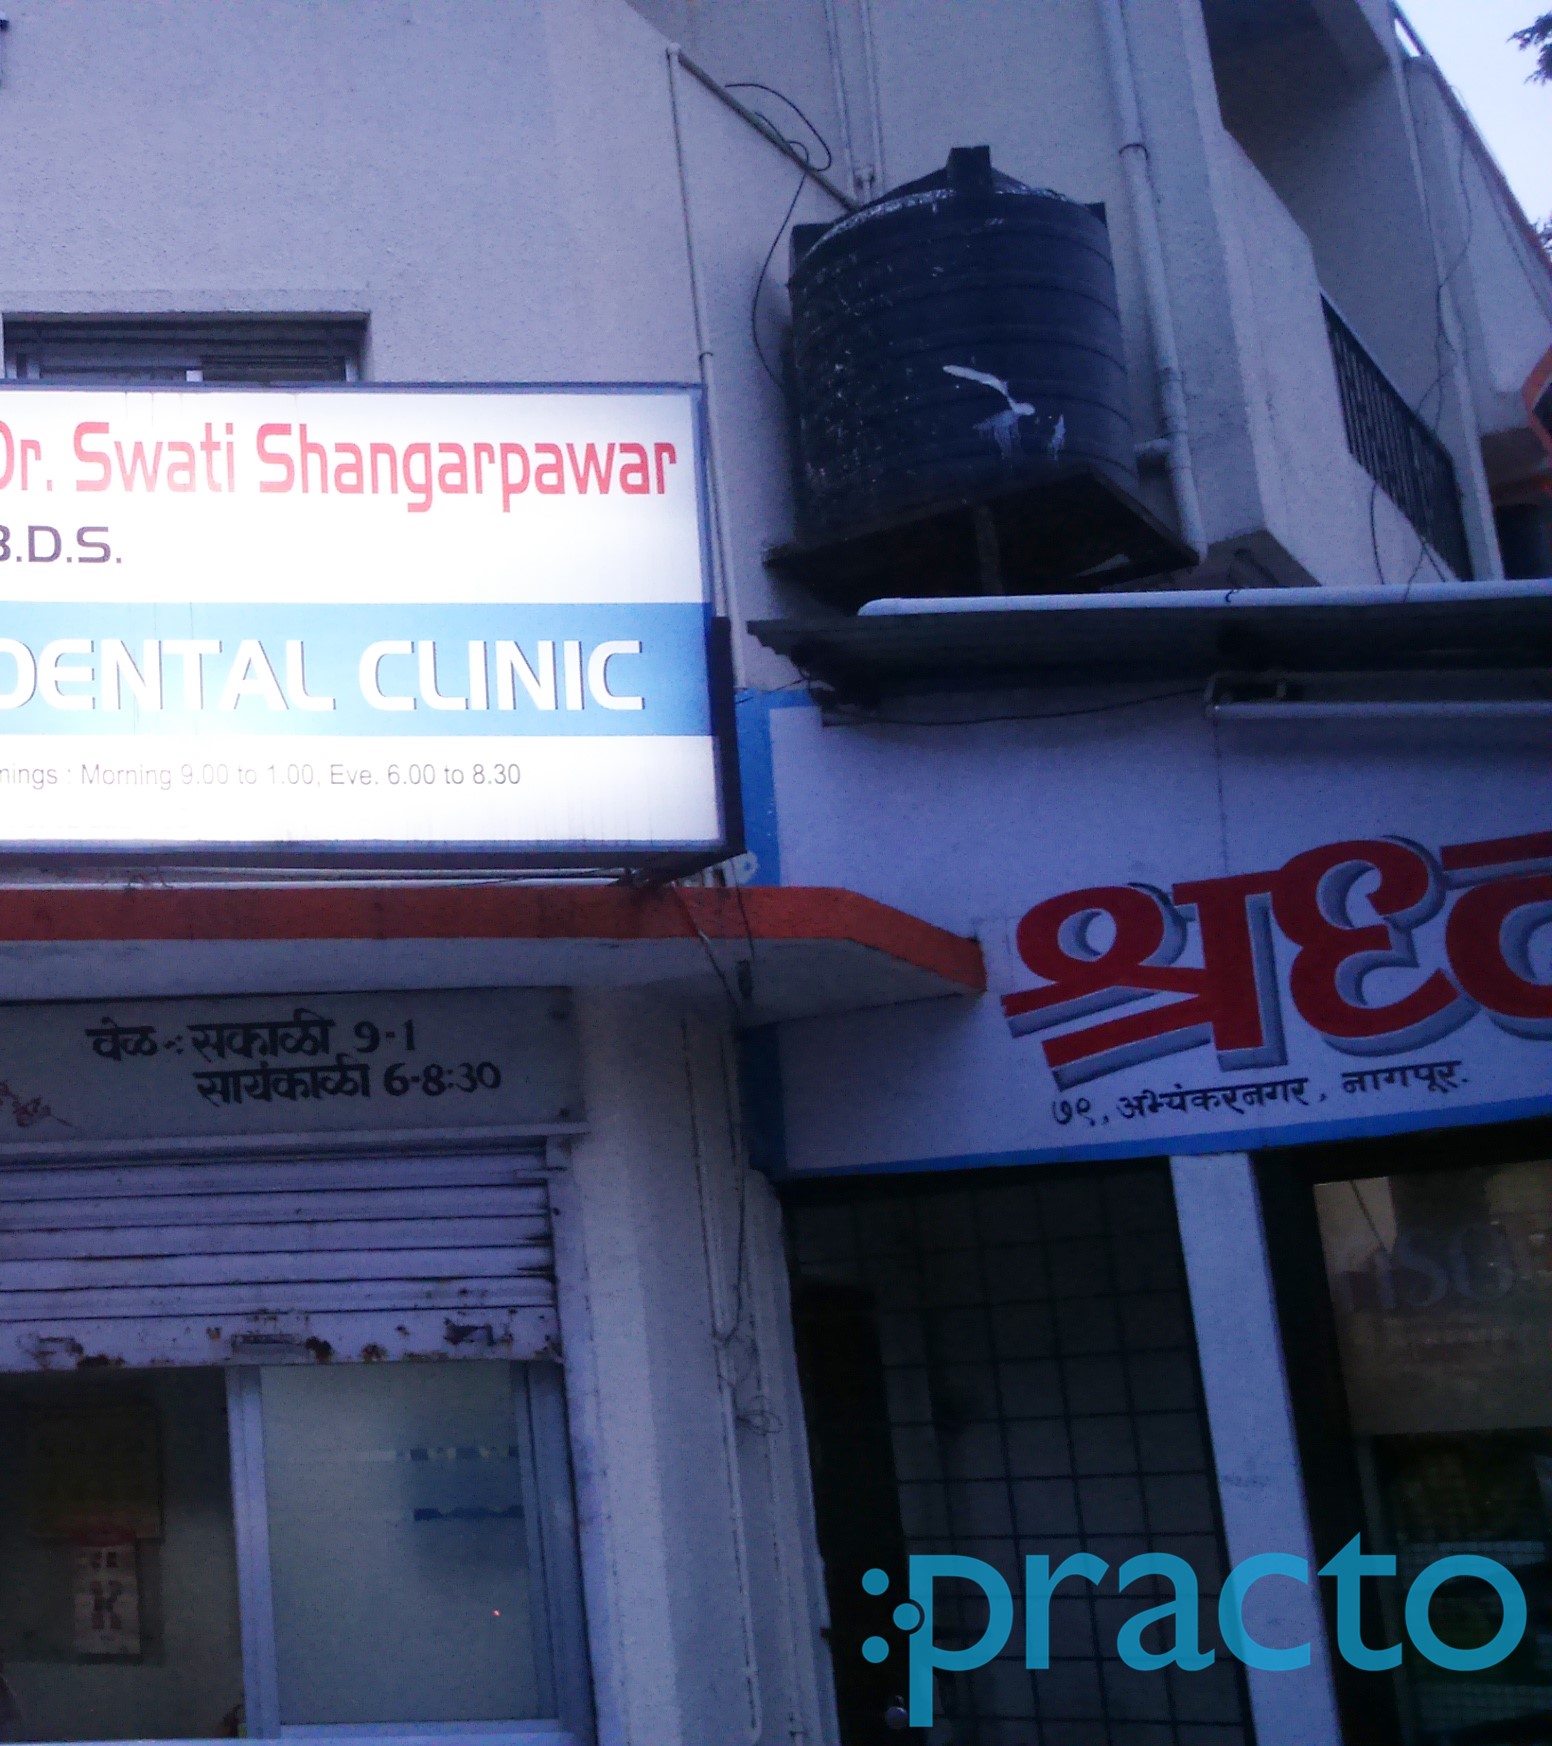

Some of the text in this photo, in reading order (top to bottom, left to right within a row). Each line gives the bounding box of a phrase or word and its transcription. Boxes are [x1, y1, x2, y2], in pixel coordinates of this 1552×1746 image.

[73, 421, 237, 494] Swati
[256, 423, 677, 513] Shangarpawar
[359, 639, 646, 713] CLINIC
[82, 763, 171, 790] Morning
[181, 763, 230, 786] 9.00
[238, 764, 257, 786] to
[331, 764, 379, 786] Eve.
[387, 764, 436, 786] 6.00
[444, 764, 464, 786] to
[472, 764, 522, 786] 8.30
[187, 1007, 335, 1062] सकाळी
[193, 1053, 501, 1107] सायंकाळी 6-8:30
